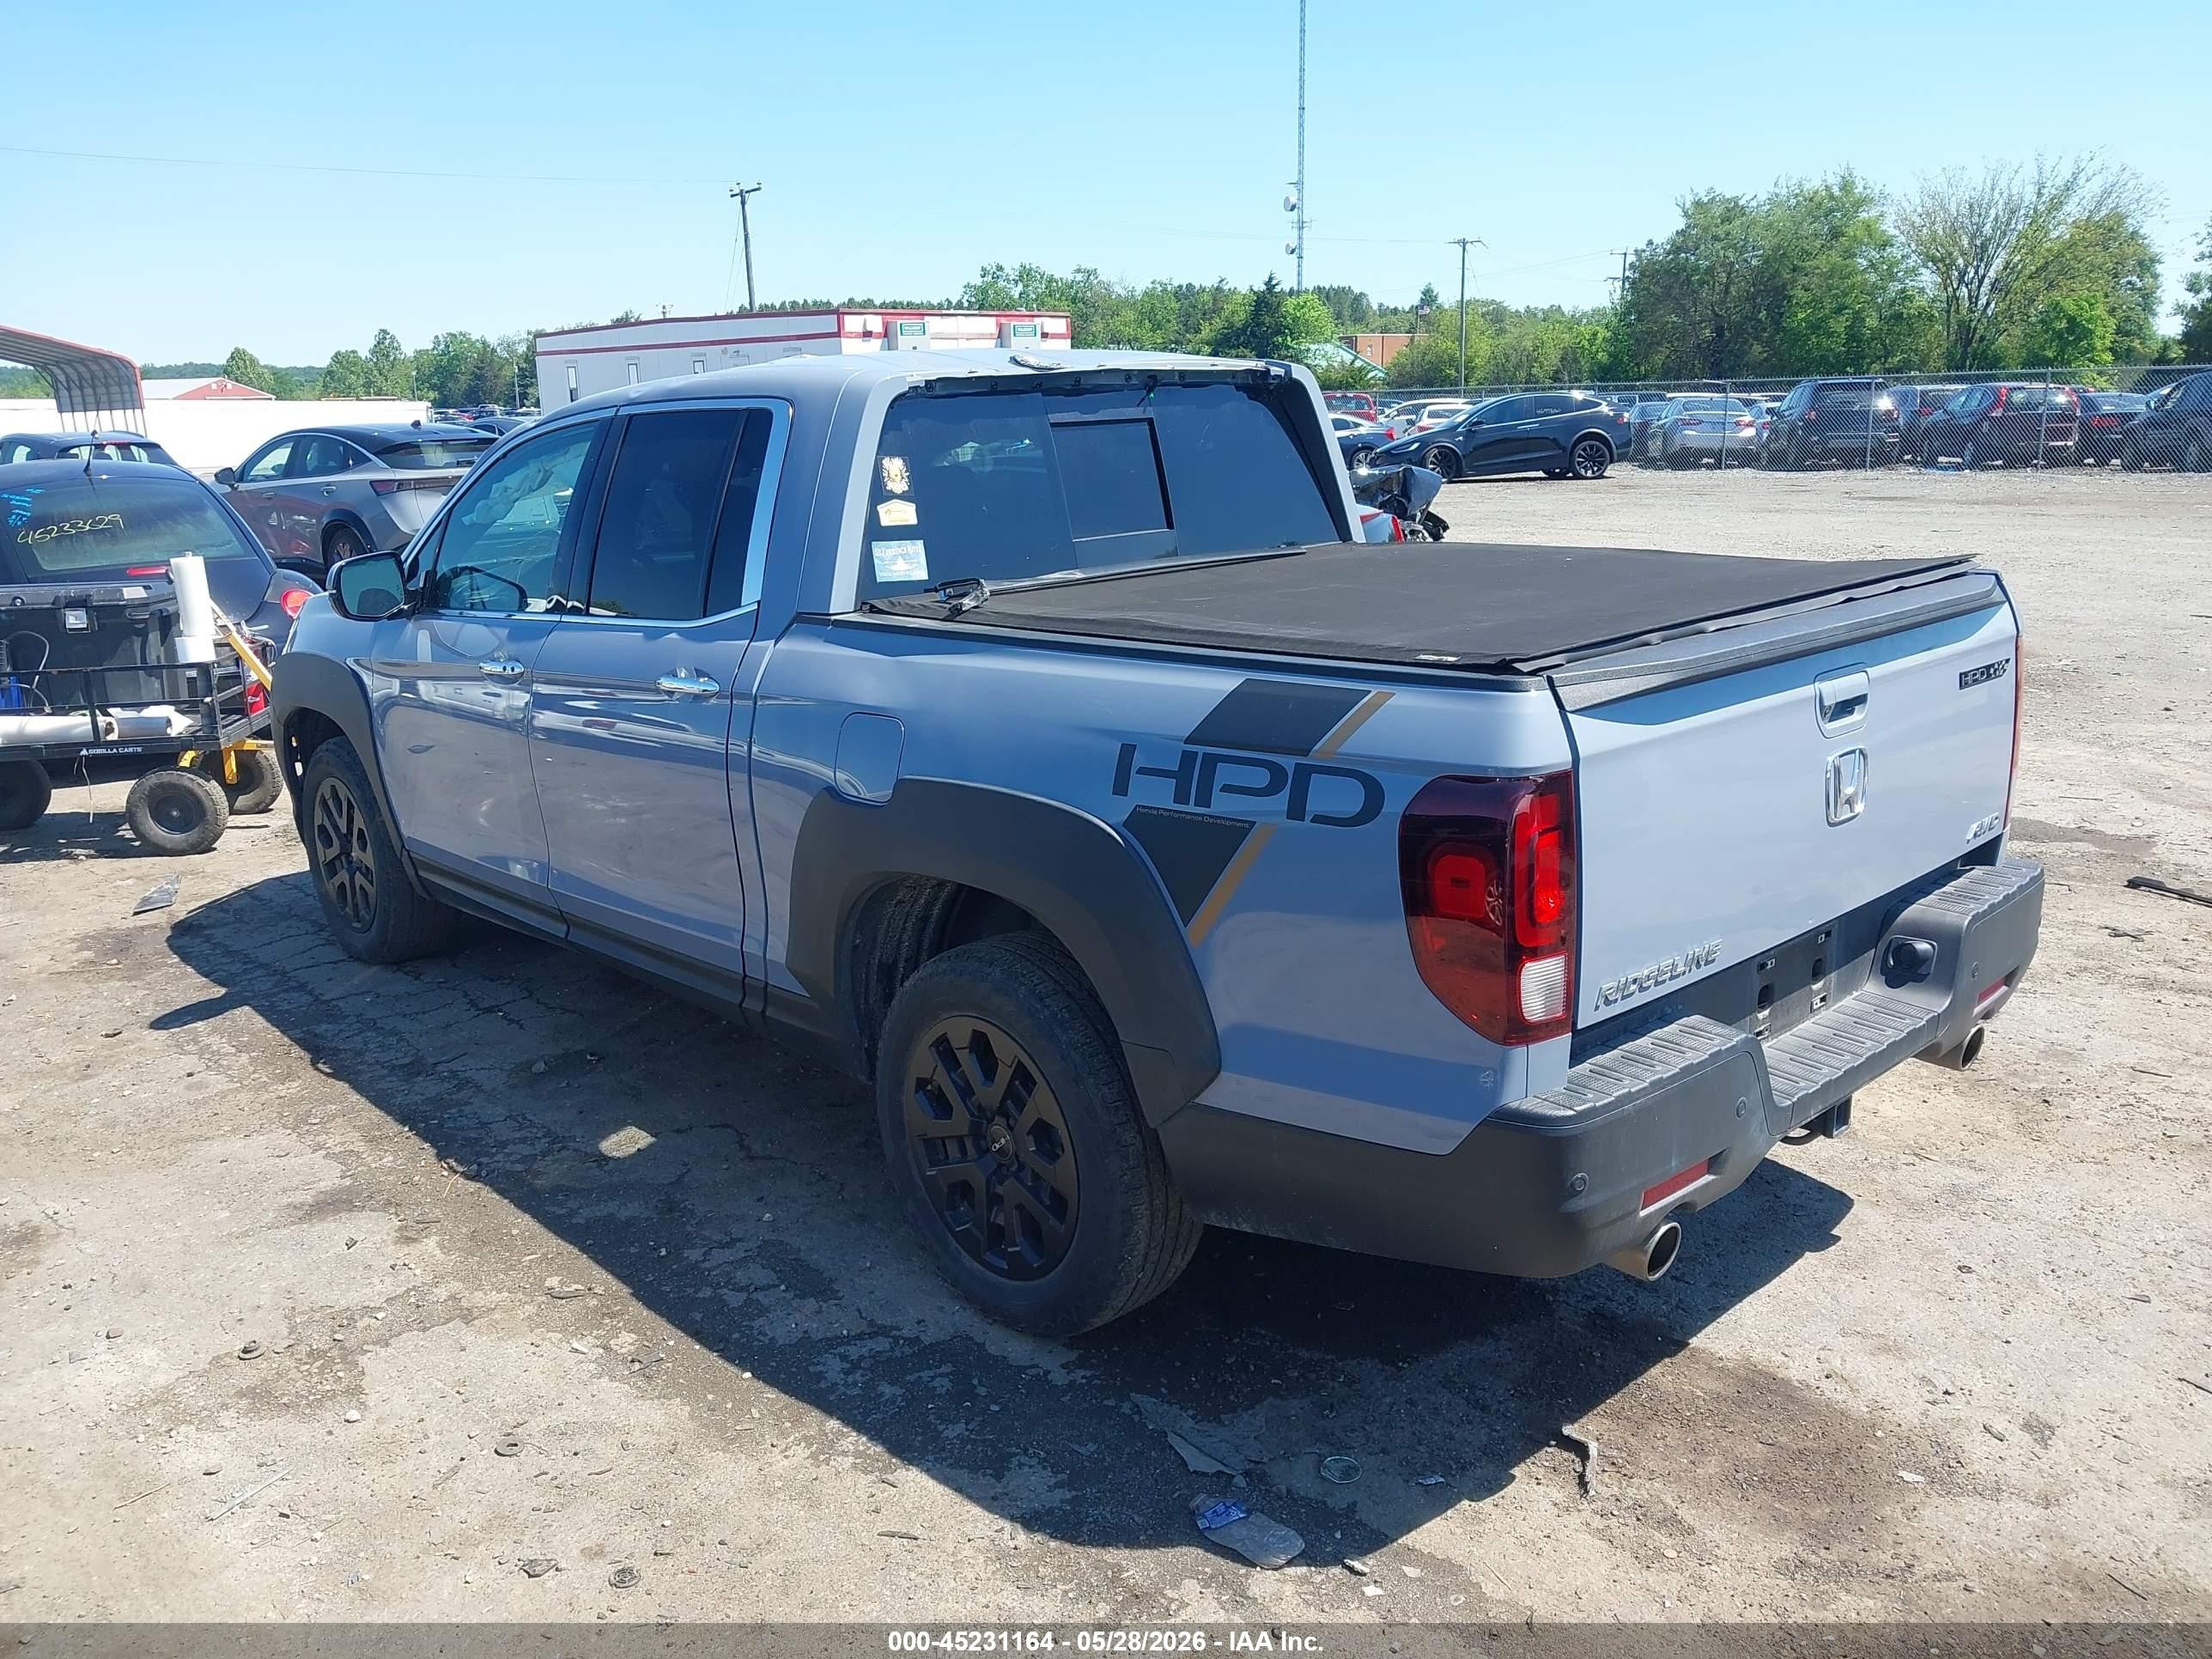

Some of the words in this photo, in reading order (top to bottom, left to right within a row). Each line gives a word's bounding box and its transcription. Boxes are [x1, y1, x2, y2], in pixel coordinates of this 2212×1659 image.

[1961, 667, 1987, 687] HPD
[1111, 742, 1386, 828] HPD
[1135, 805, 1158, 815] Honda
[1158, 809, 1203, 822] Performance
[1203, 815, 1250, 829] Development
[1594, 938, 1723, 1012] RIDGELINE
